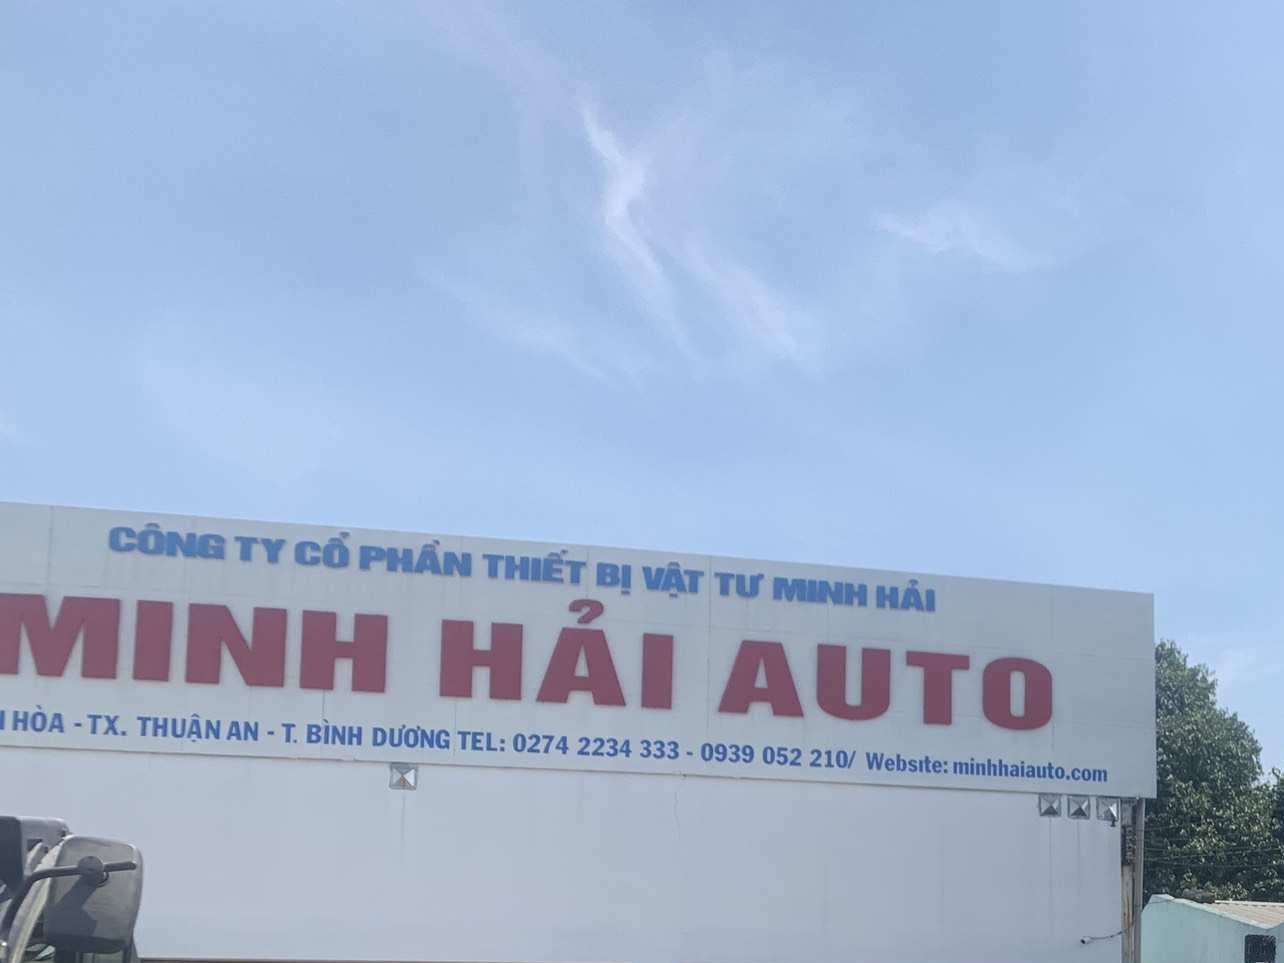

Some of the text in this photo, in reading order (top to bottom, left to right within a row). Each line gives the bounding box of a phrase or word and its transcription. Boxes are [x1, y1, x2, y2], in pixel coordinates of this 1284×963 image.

[108, 522, 226, 560] CÔNG
[234, 536, 286, 564] TY
[294, 531, 350, 569] CỔ
[482, 549, 586, 584] THIẾT
[595, 562, 631, 595] BỊ
[642, 561, 704, 598] VẬT
[714, 572, 764, 598] TƯ
[773, 576, 867, 607] MINH
[876, 579, 936, 612] HẢI
[0, 593, 1053, 730] MINH HẢI AUTO
[12, 705, 65, 733] HÒA
[87, 714, 127, 736] TX.
[137, 713, 221, 742] THUẬN
[226, 720, 259, 741] AN
[281, 723, 297, 743] T.
[306, 719, 362, 746] BÌNH
[372, 724, 450, 750] DƯƠNG
[457, 730, 505, 752] TEL:
[513, 733, 569, 755] 0274
[577, 736, 632, 758] 2234
[640, 739, 679, 760] 333
[701, 742, 754, 763] 0939
[762, 746, 801, 766] 052
[810, 749, 856, 769] 210/
[953, 757, 1108, 782] minhhaiauto.com
